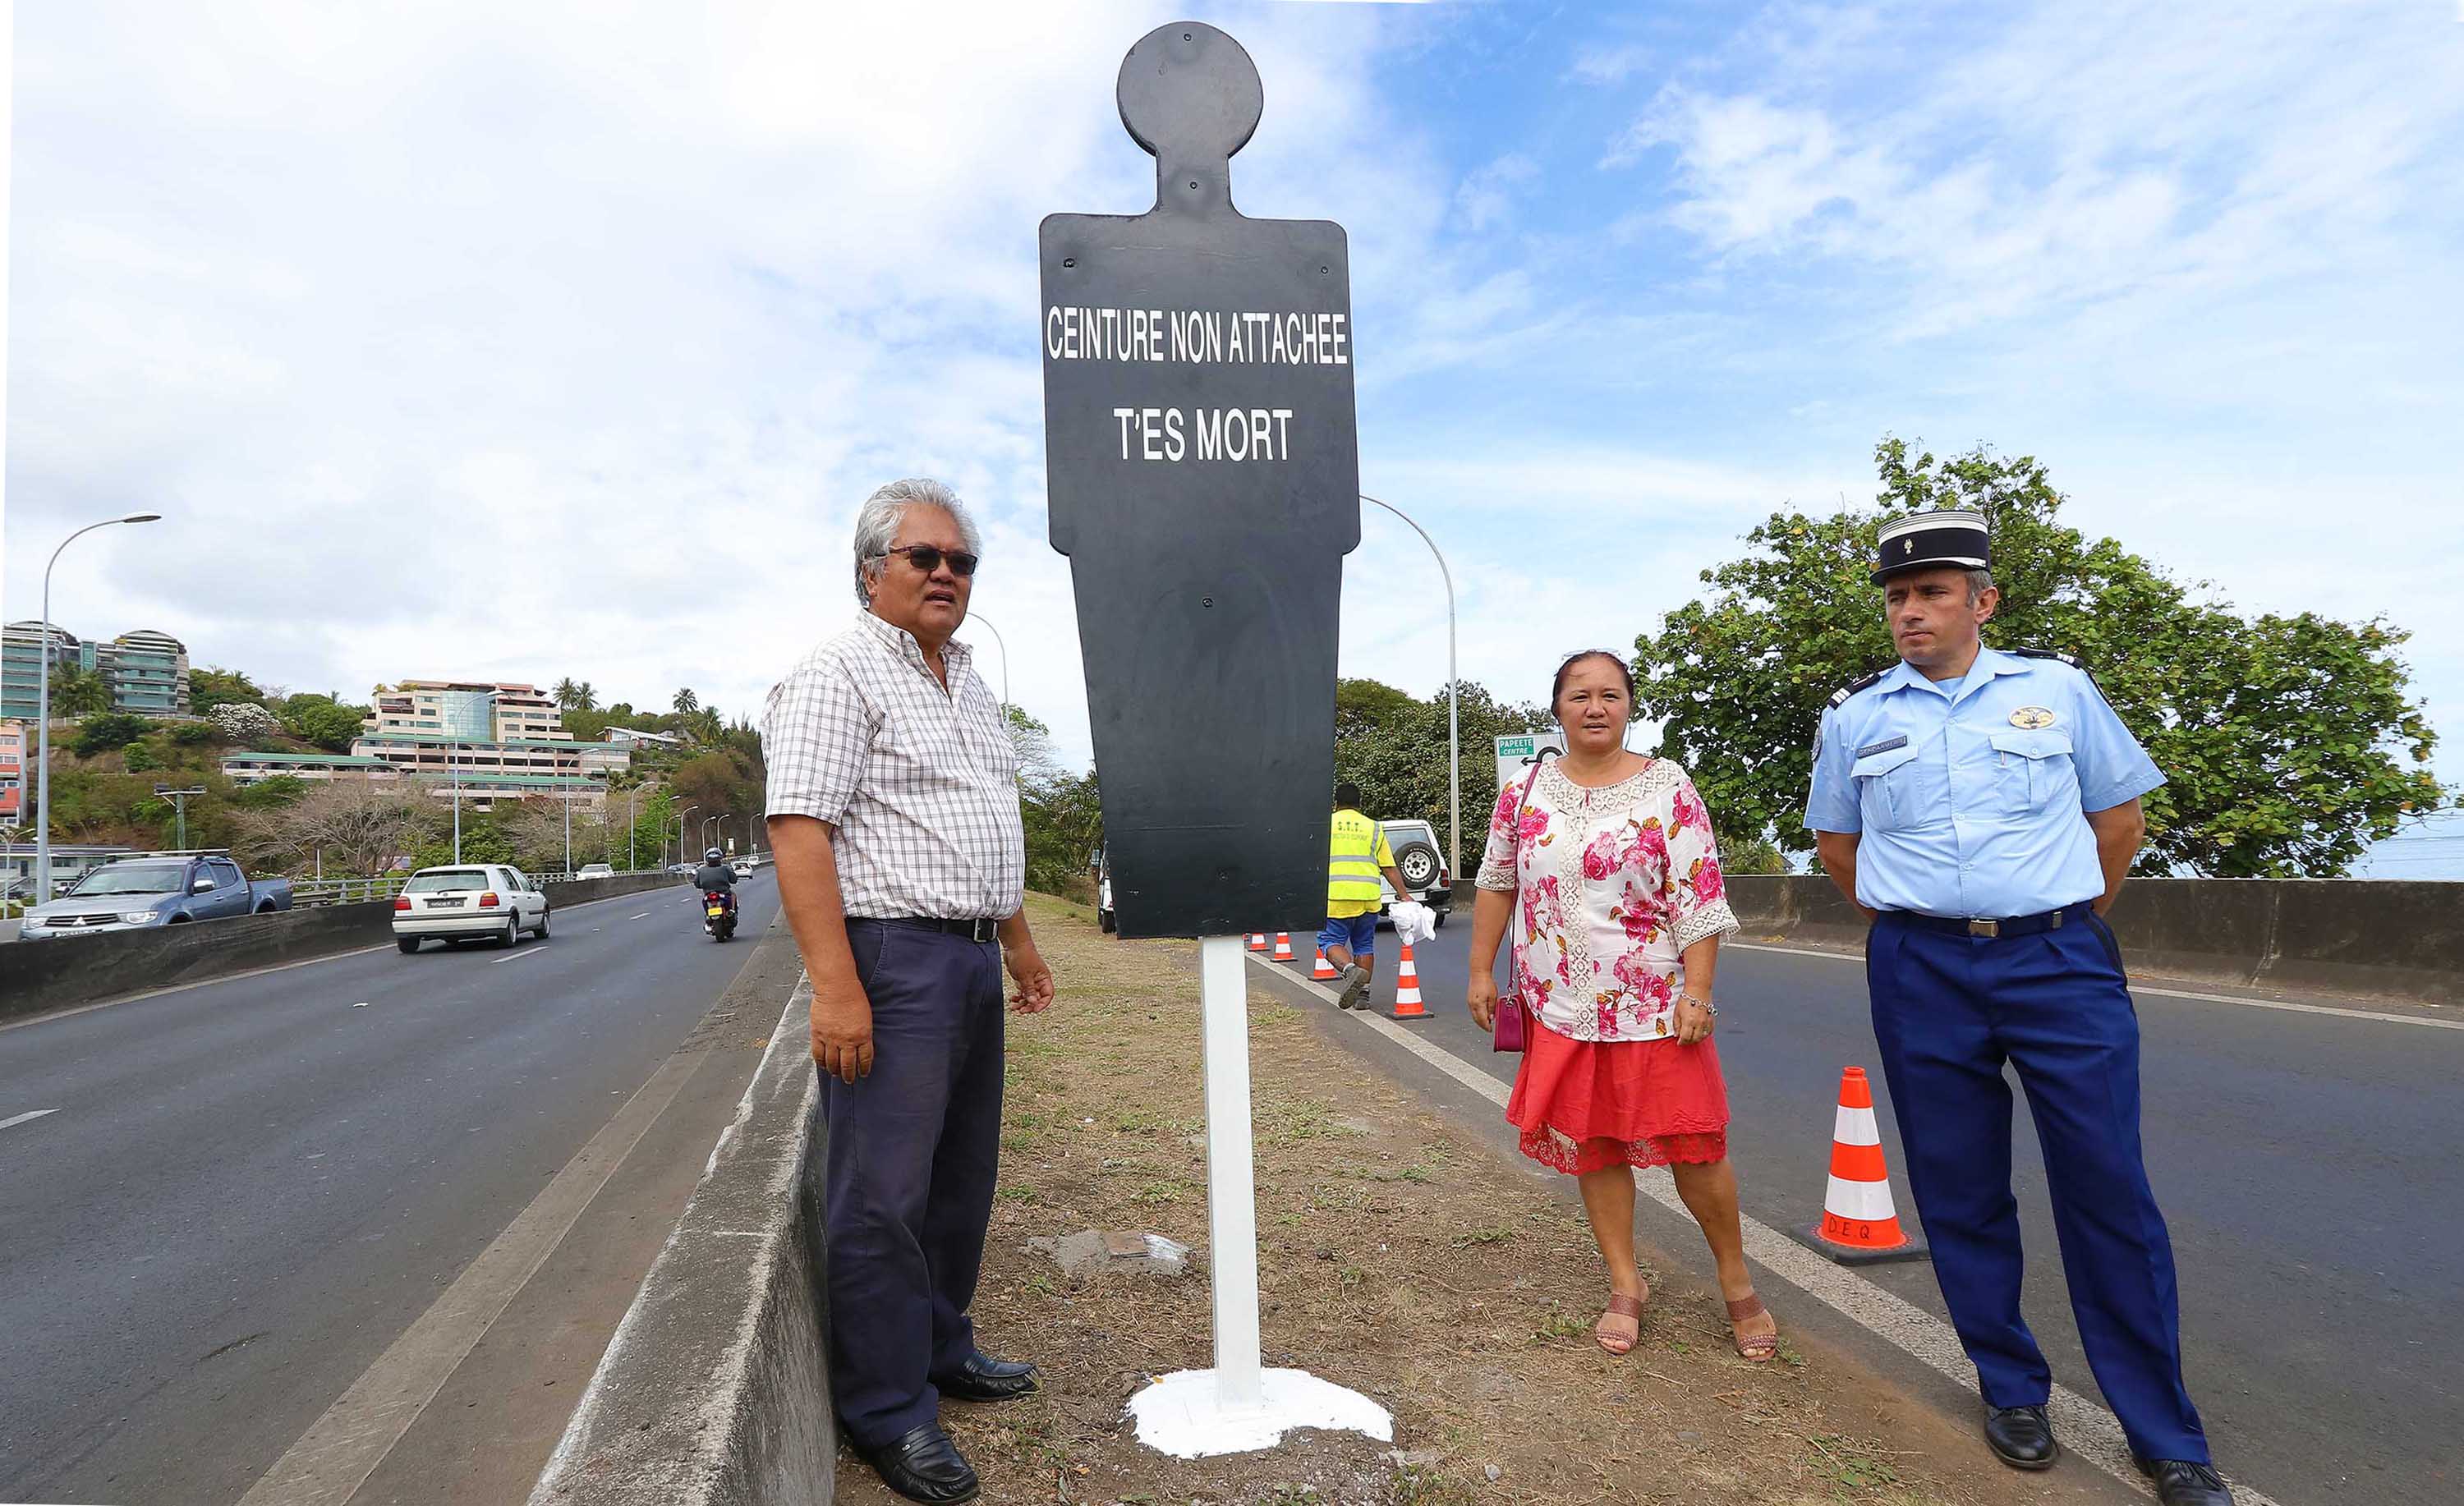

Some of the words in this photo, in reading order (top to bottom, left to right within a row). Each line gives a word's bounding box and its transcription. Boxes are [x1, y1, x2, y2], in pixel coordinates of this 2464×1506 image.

[1047, 305, 1164, 361] CEINTURE
[1171, 311, 1221, 364] NON
[1229, 312, 1348, 365] ATTACHEE
[1114, 407, 1186, 461] T'ES
[1196, 408, 1293, 461] MORT
[1500, 738, 1533, 748] PAPEETE
